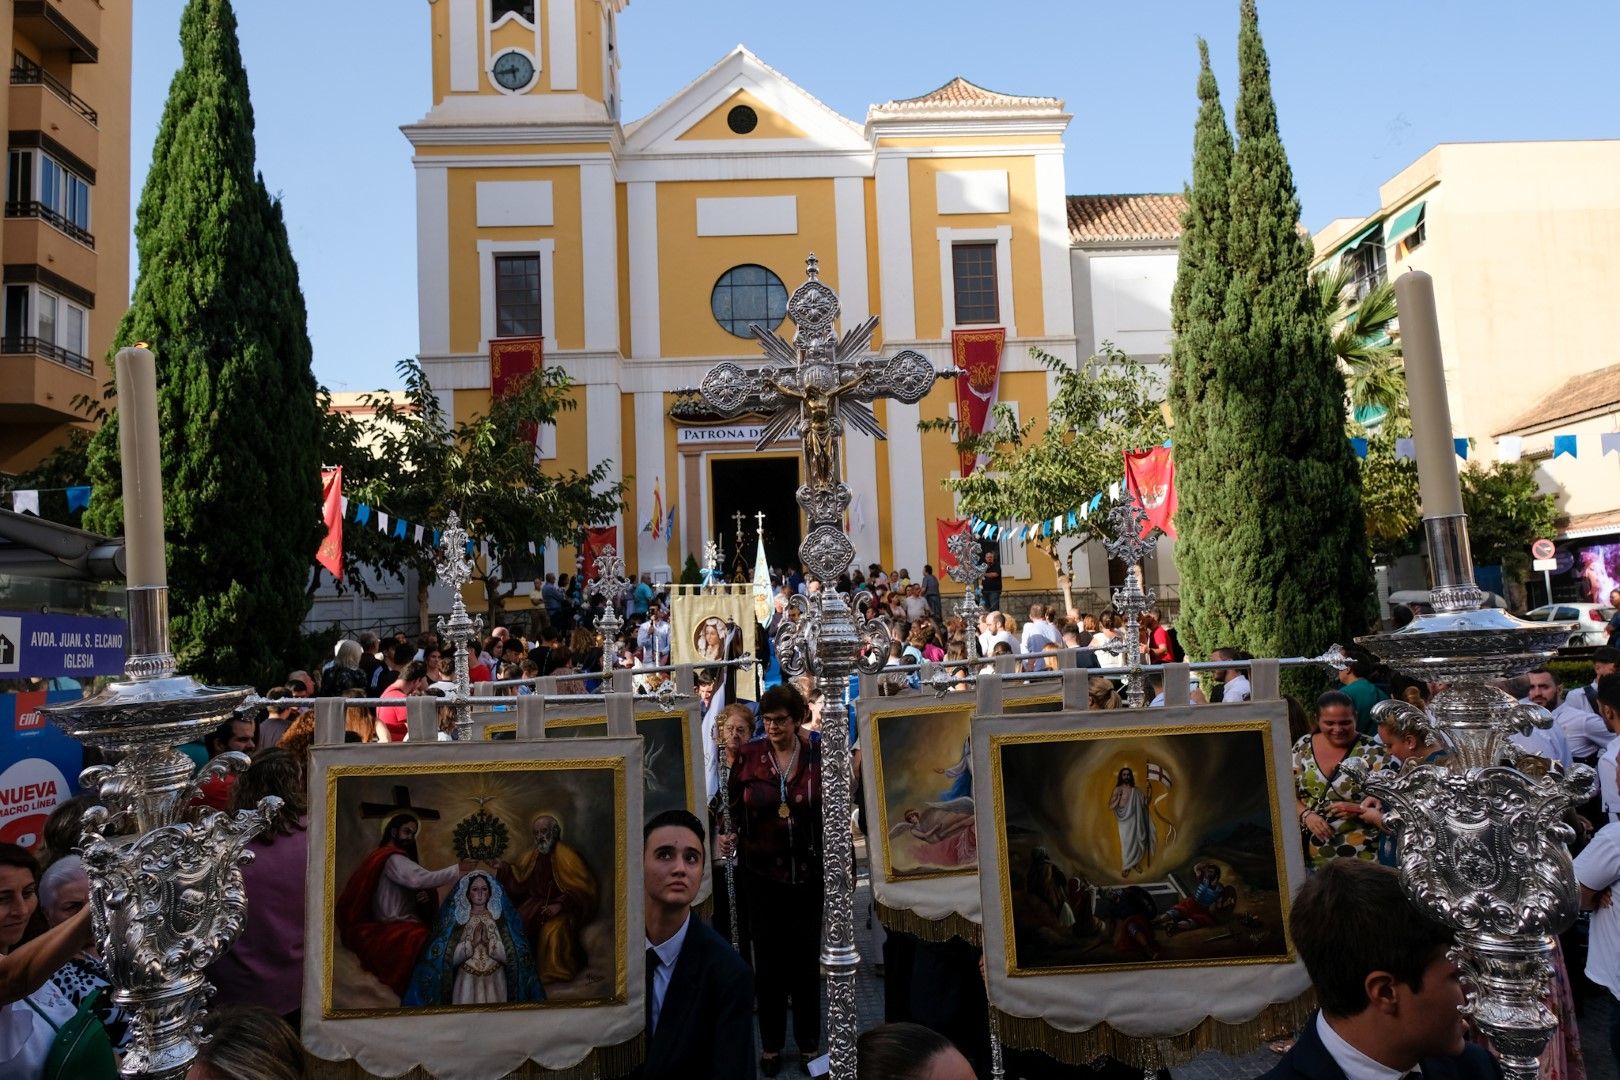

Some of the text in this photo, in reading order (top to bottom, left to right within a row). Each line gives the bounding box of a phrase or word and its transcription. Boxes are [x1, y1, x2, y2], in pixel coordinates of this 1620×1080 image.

[684, 429, 745, 440] PATRONA
[31, 631, 123, 649] AVDA. JUAN. S. ELCANO
[63, 653, 95, 669] IGLESIA
[0, 780, 57, 806] NUEVA
